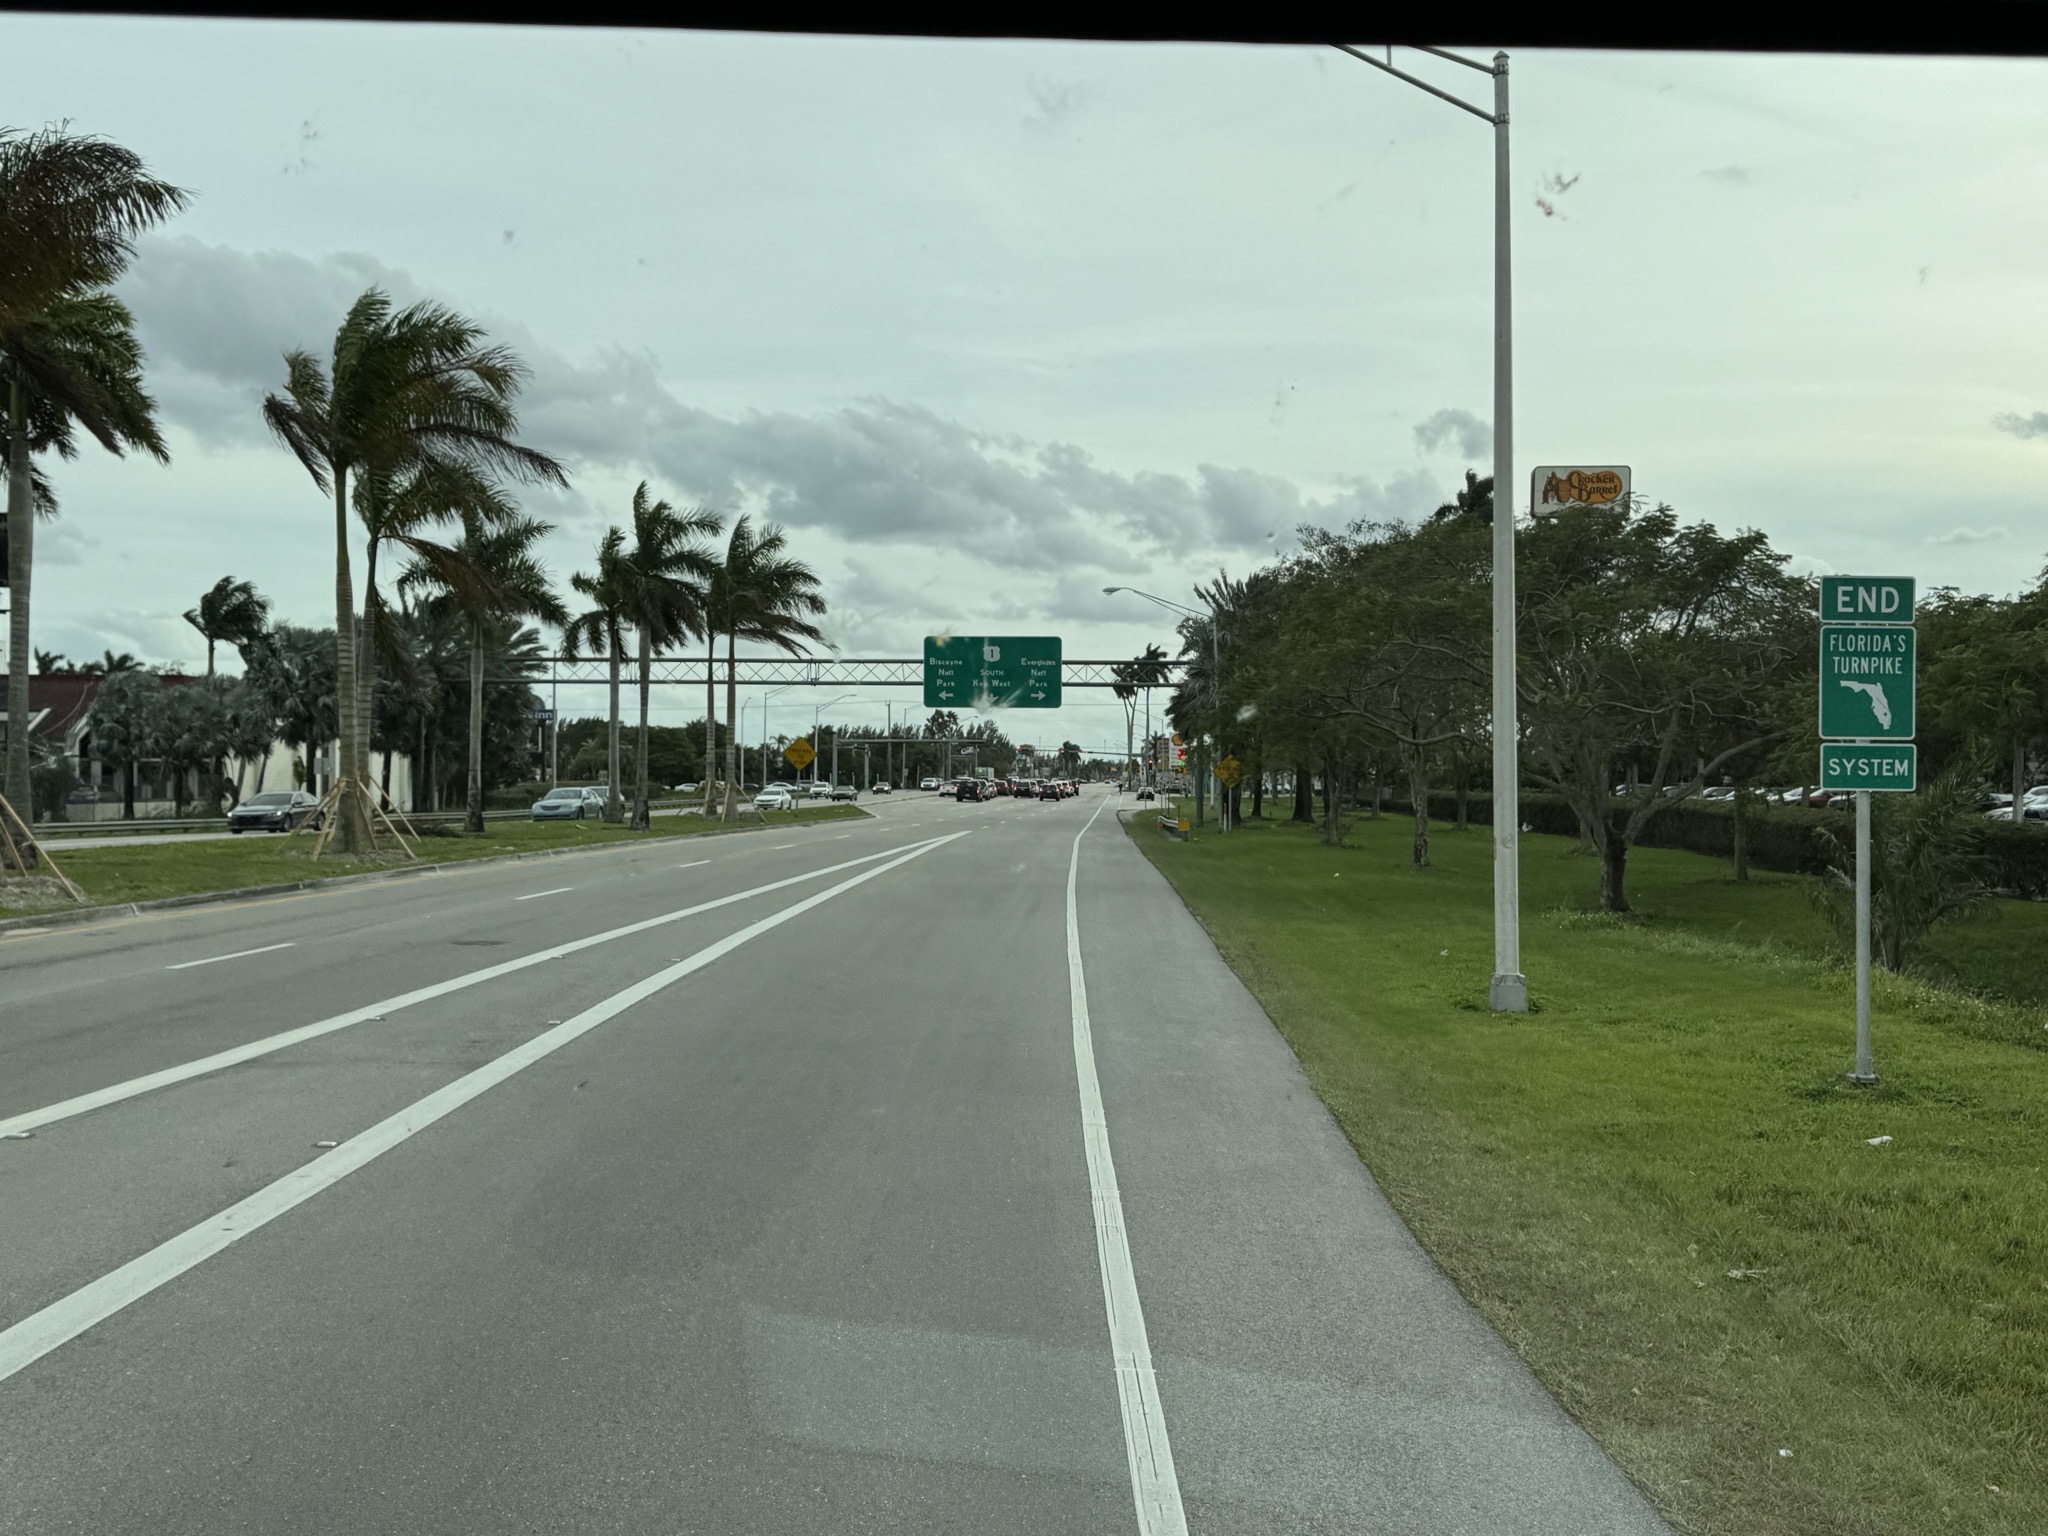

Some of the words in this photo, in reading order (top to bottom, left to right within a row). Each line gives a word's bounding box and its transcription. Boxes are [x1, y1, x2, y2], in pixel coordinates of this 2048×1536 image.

[1837, 586, 1900, 614] END
[1830, 634, 1906, 652] FLORIDA'S
[929, 657, 963, 667] Biscayne
[1021, 657, 1056, 667] Everglades
[1833, 657, 1903, 675] TURNPIKE
[936, 679, 955, 687] Park
[992, 679, 1011, 687] West
[1029, 679, 1048, 687] Park
[1828, 758, 1909, 777] SYSTEM
